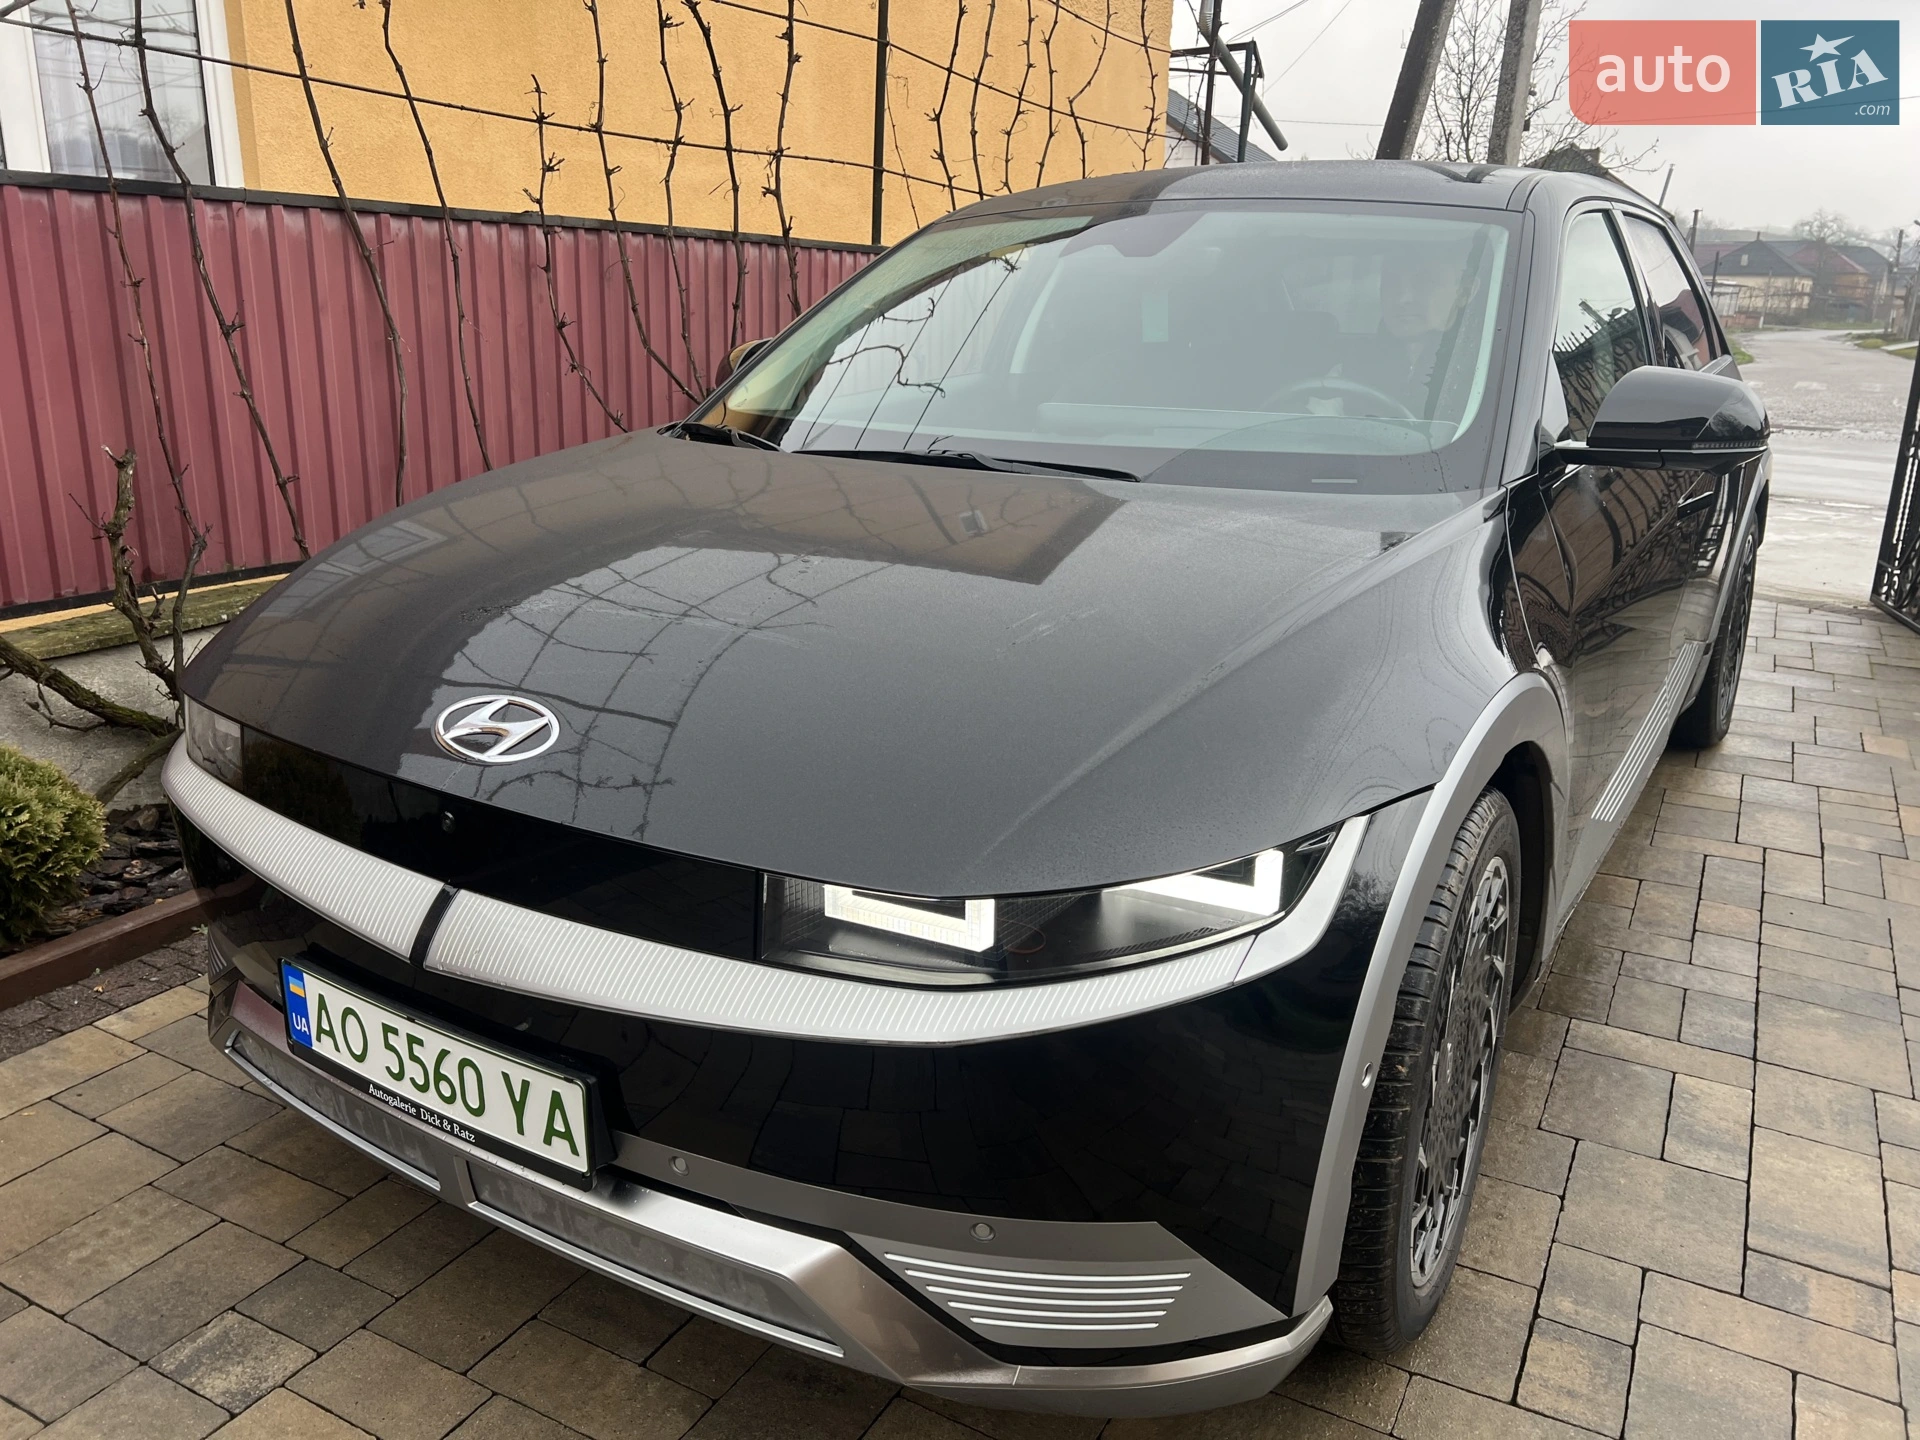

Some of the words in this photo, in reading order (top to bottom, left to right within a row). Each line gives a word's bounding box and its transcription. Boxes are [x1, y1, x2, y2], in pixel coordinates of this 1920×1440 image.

[292, 1012, 310, 1036] UA
[315, 993, 369, 1064] AO
[381, 1021, 487, 1118] 5560
[501, 1070, 580, 1157] YA
[368, 1083, 417, 1116] Autogalerie
[419, 1108, 442, 1128] Dick
[442, 1118, 452, 1132] &
[453, 1123, 476, 1143] Ratz
